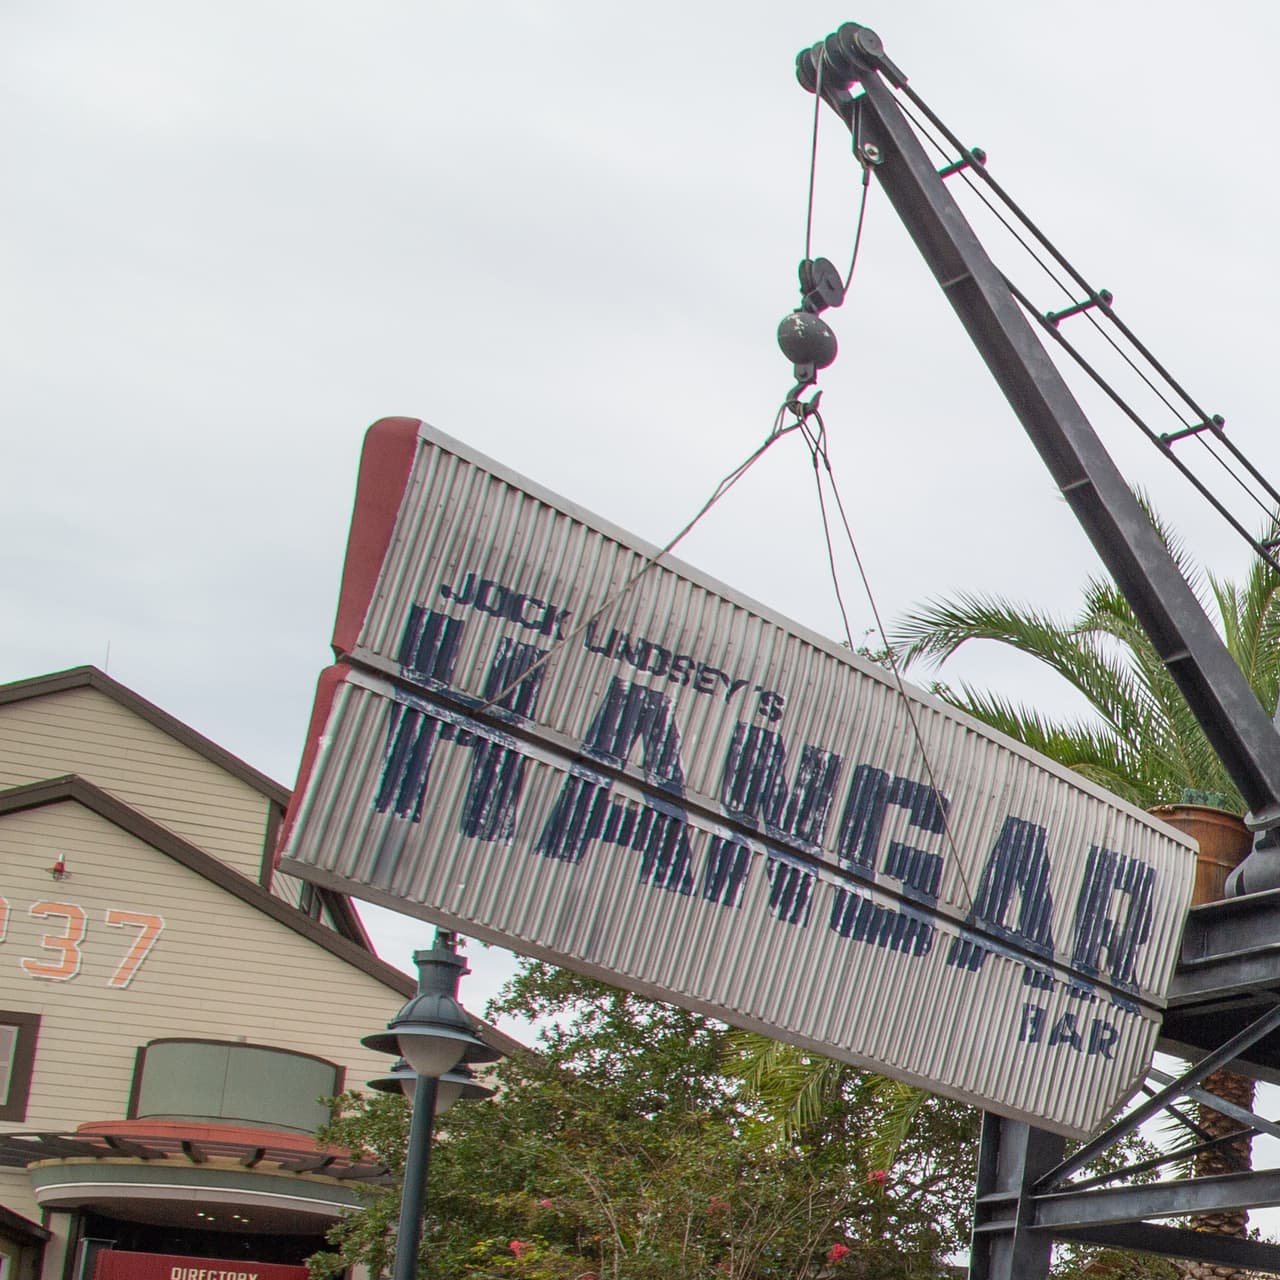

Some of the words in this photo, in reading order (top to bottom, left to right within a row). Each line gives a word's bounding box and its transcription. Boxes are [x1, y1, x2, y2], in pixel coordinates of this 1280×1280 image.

[440, 572, 571, 641] JOCK
[584, 620, 786, 723] LINDSEY'S
[374, 602, 1158, 1016] HANGAR
[0, 896, 165, 989] 37
[1018, 1002, 1119, 1060] BAR
